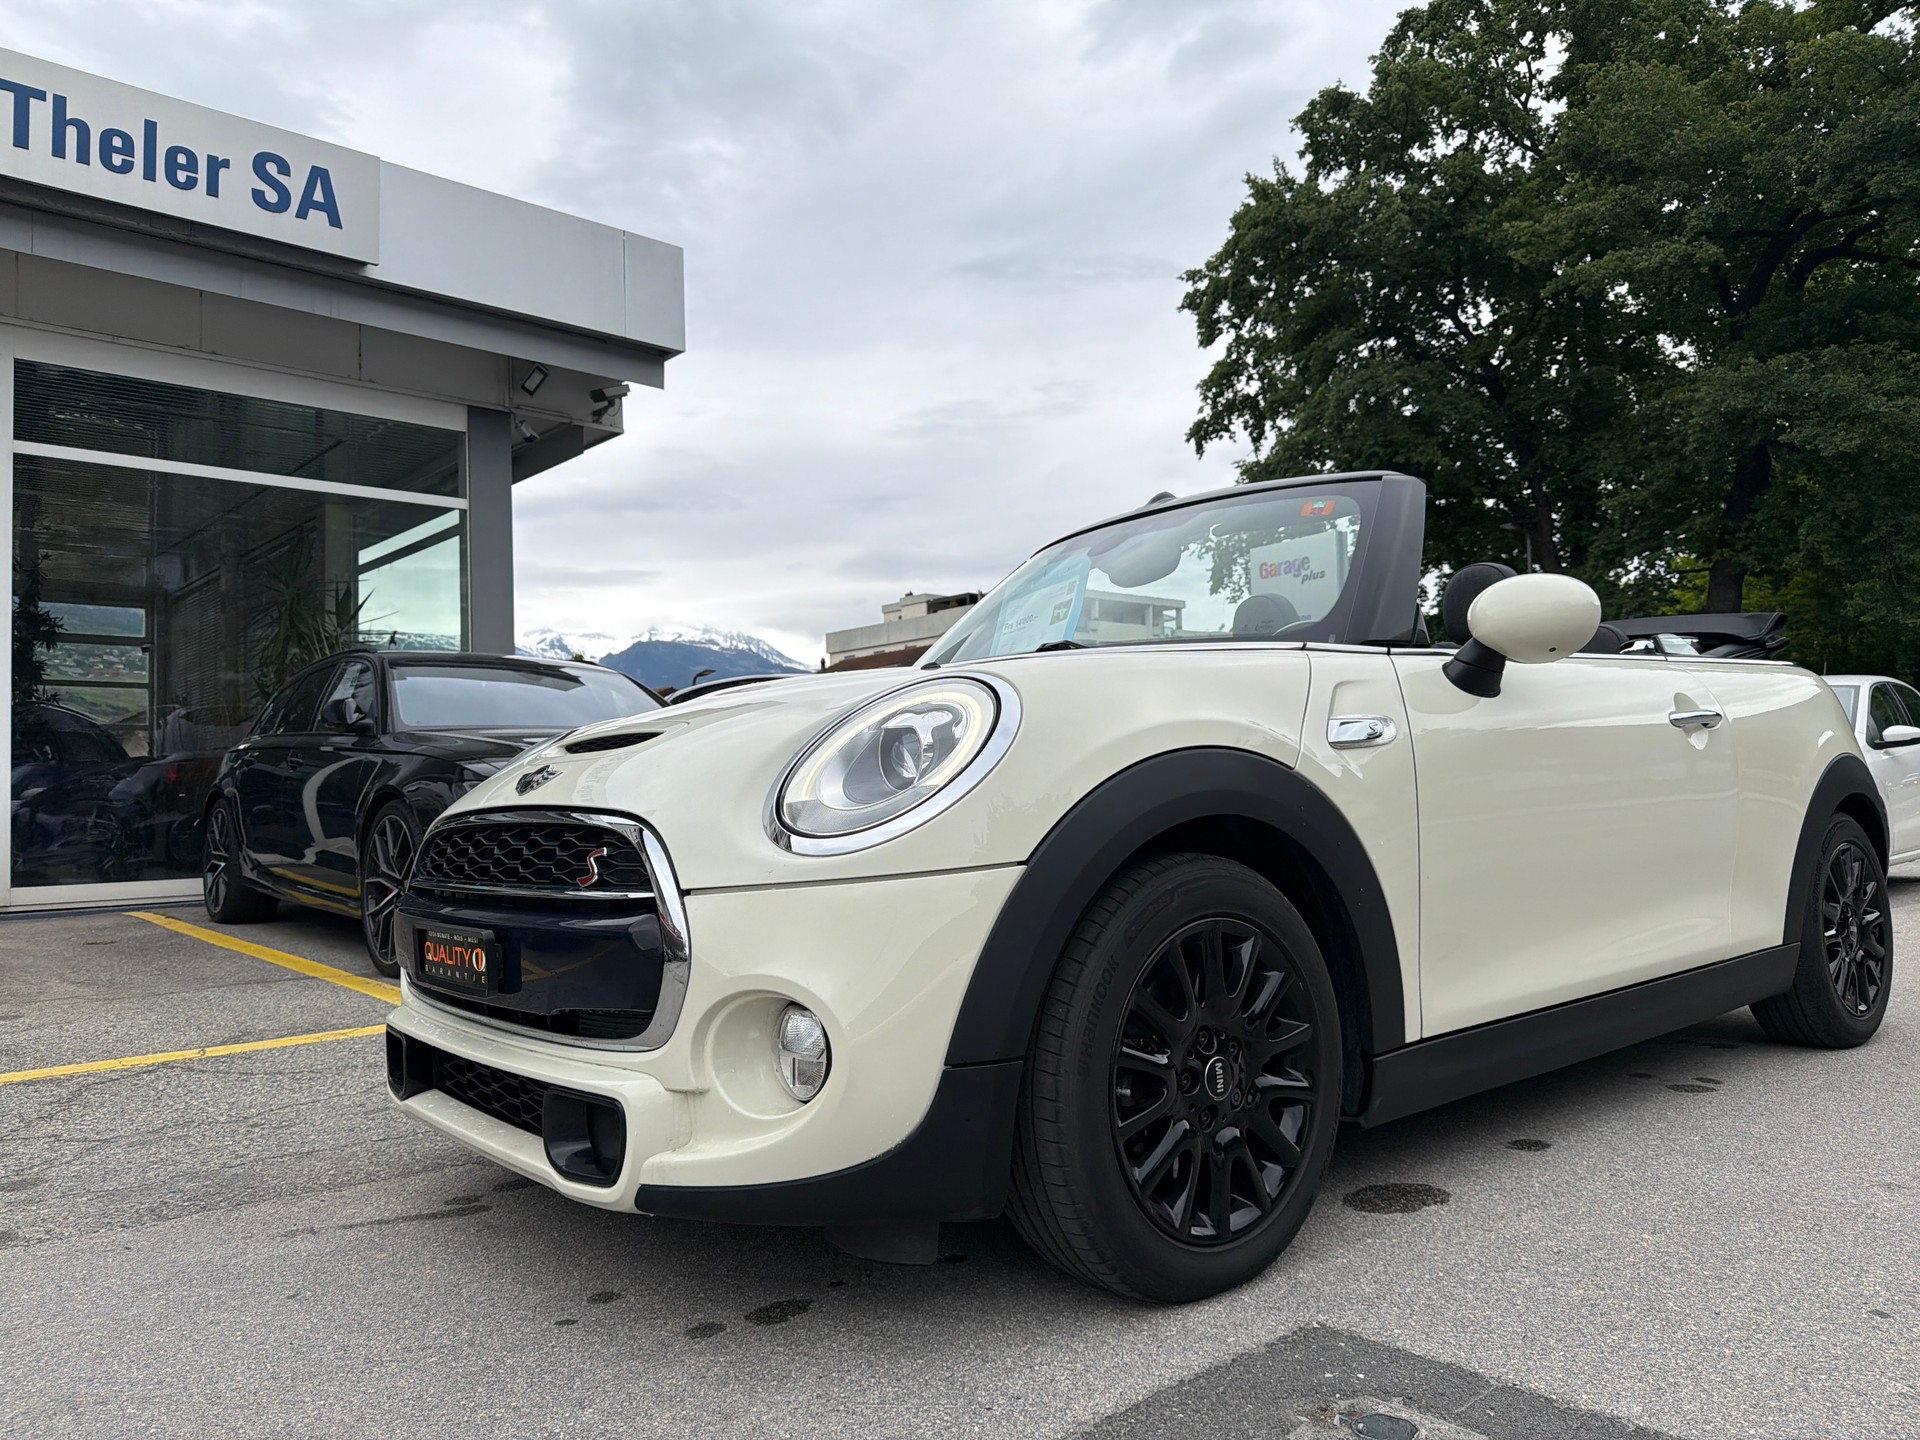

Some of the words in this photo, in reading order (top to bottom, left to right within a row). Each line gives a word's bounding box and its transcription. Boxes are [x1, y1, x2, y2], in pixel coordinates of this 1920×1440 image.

[0, 78, 230, 198] Theler
[251, 151, 344, 230] SA
[1258, 556, 1311, 580] Garage
[1297, 570, 1326, 585] plus
[576, 847, 607, 888] S
[424, 941, 471, 968] QUALITY
[424, 964, 486, 984] GARANTIE
[1215, 1062, 1225, 1093] MINI
